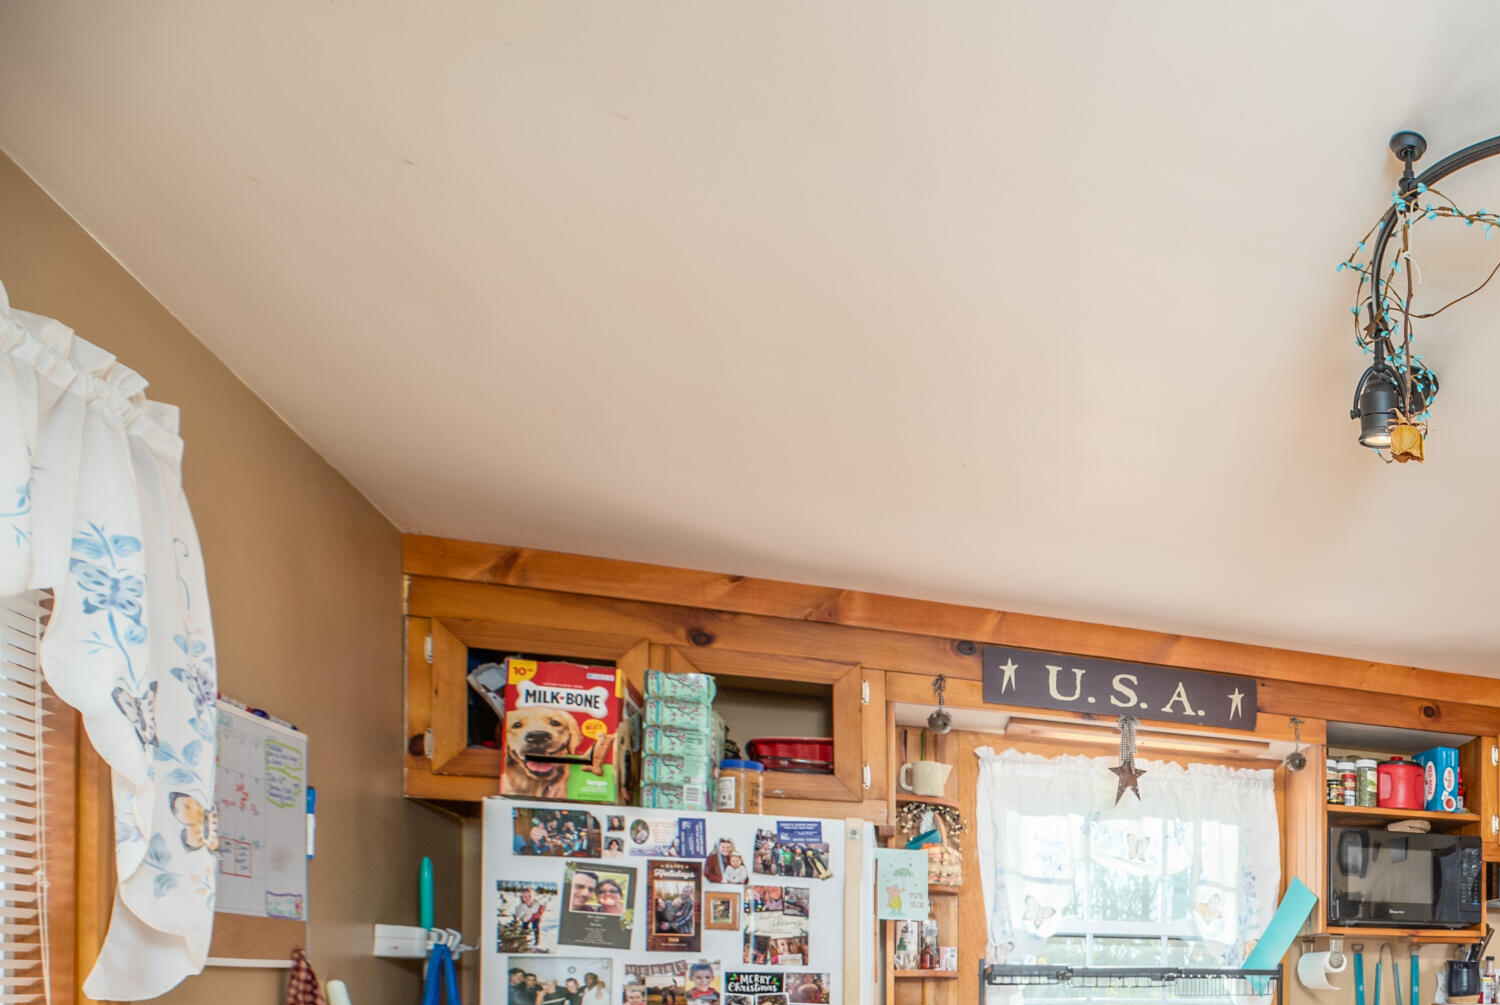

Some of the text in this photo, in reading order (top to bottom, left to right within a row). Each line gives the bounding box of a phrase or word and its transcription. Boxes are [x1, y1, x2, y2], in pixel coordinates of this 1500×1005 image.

[513, 666, 527, 676] 10
[1045, 664, 1205, 717] U.S.A.
[739, 973, 772, 985] MERRY
[727, 981, 778, 992] Christmas
